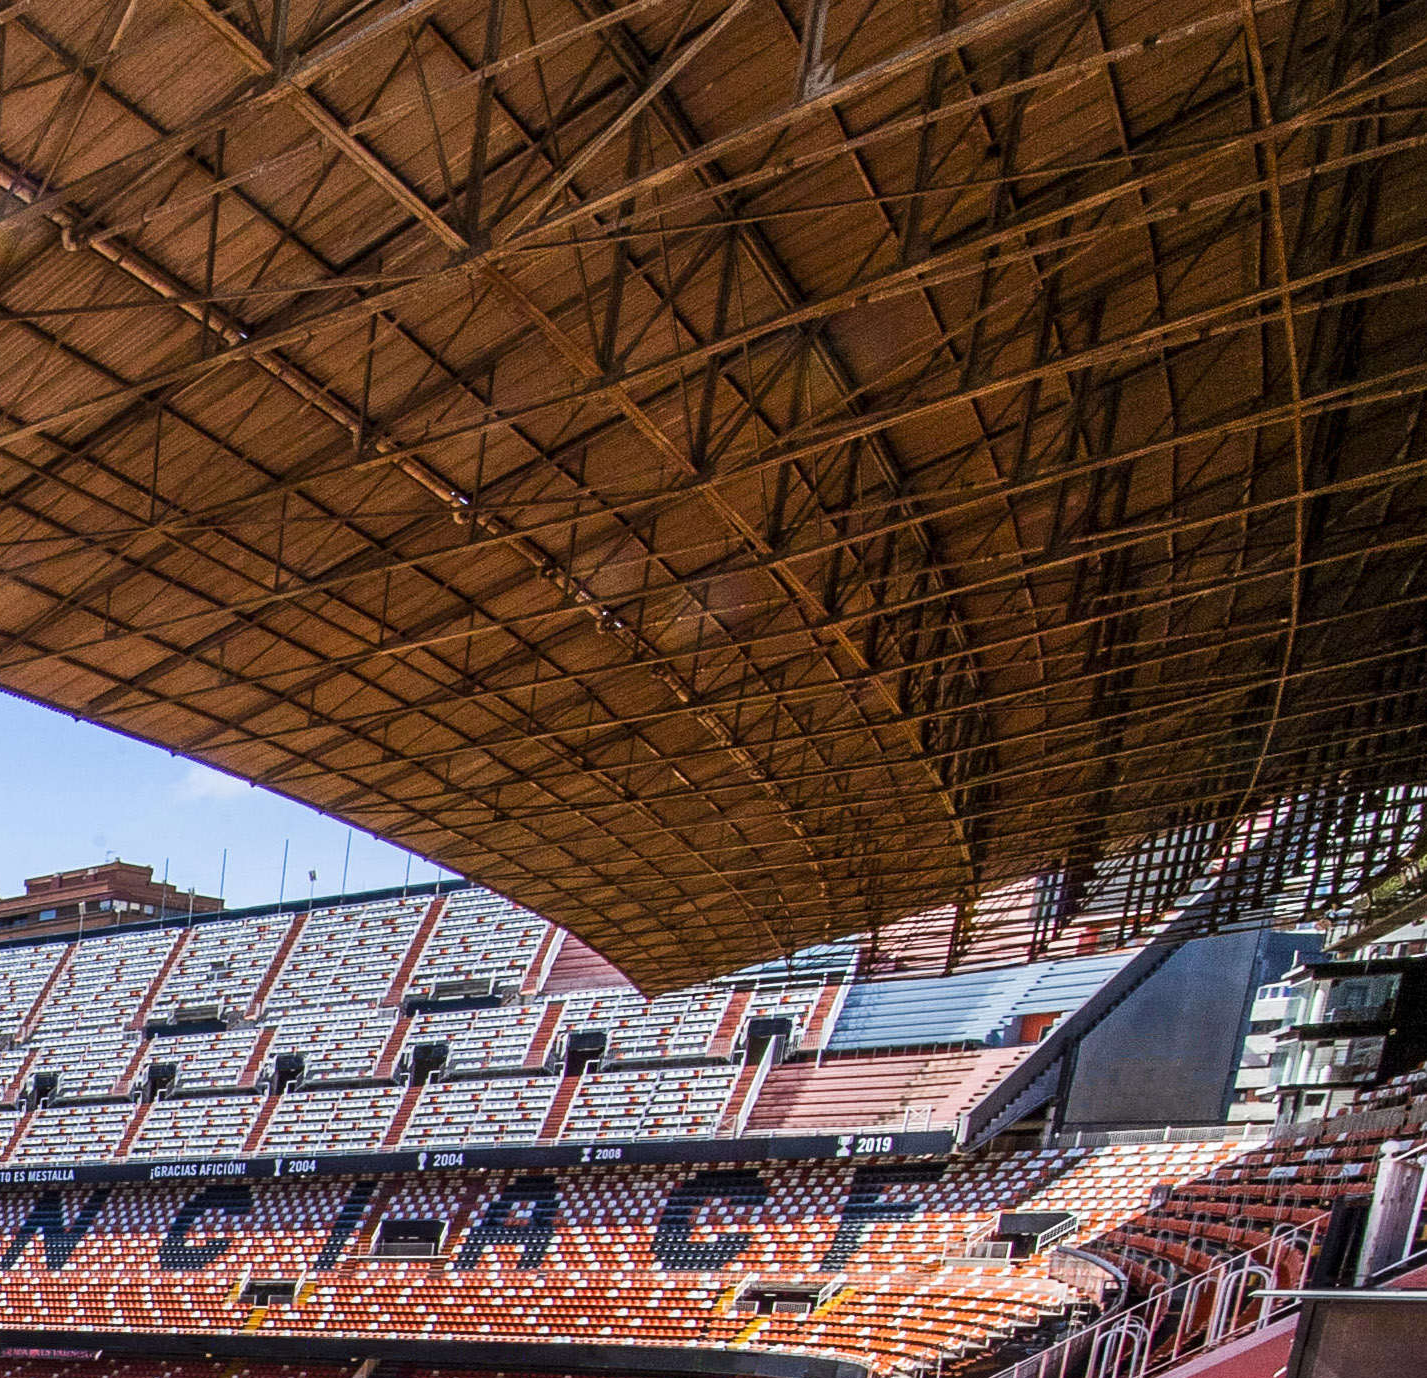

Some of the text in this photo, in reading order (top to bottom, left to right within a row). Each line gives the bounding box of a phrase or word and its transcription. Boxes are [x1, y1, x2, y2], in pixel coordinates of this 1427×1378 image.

[855, 1136, 893, 1153] 2019
[432, 1153, 464, 1167] 2004
[594, 1147, 622, 1160] 2008
[149, 1161, 246, 1180] ¡GRACIAS AFICIÓN!
[288, 1160, 317, 1173] 2004
[13, 1170, 25, 1182] ES
[27, 1169, 75, 1181] MESTALLA
